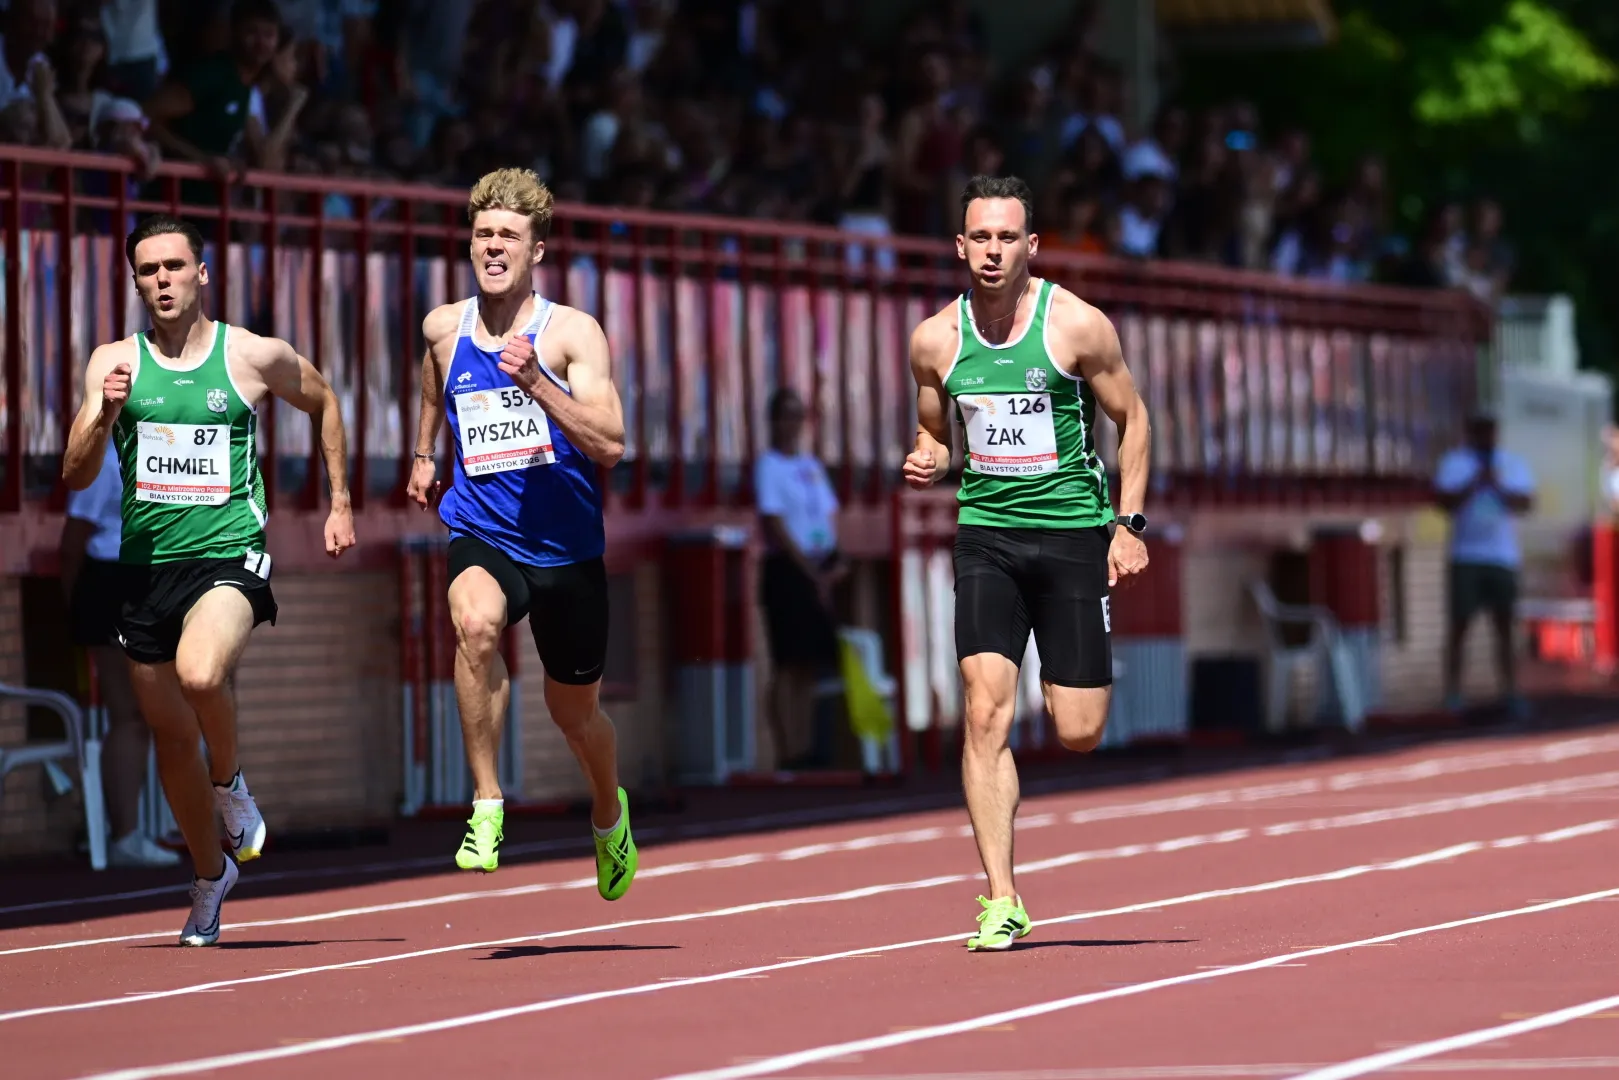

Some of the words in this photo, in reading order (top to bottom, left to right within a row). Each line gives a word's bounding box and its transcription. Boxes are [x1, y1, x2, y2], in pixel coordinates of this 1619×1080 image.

[1007, 397, 1046, 415] 126
[193, 428, 218, 446] 87
[467, 418, 540, 446] PYSZKA
[986, 424, 1026, 446] ŻAK
[146, 455, 219, 475] CHMIEL
[475, 460, 518, 473] BIAŁYSTOK
[520, 456, 540, 466] 2026
[979, 464, 1021, 473] BIAŁYSTOK
[1022, 464, 1043, 472] 2026
[149, 492, 193, 501] BIAŁYSTOK
